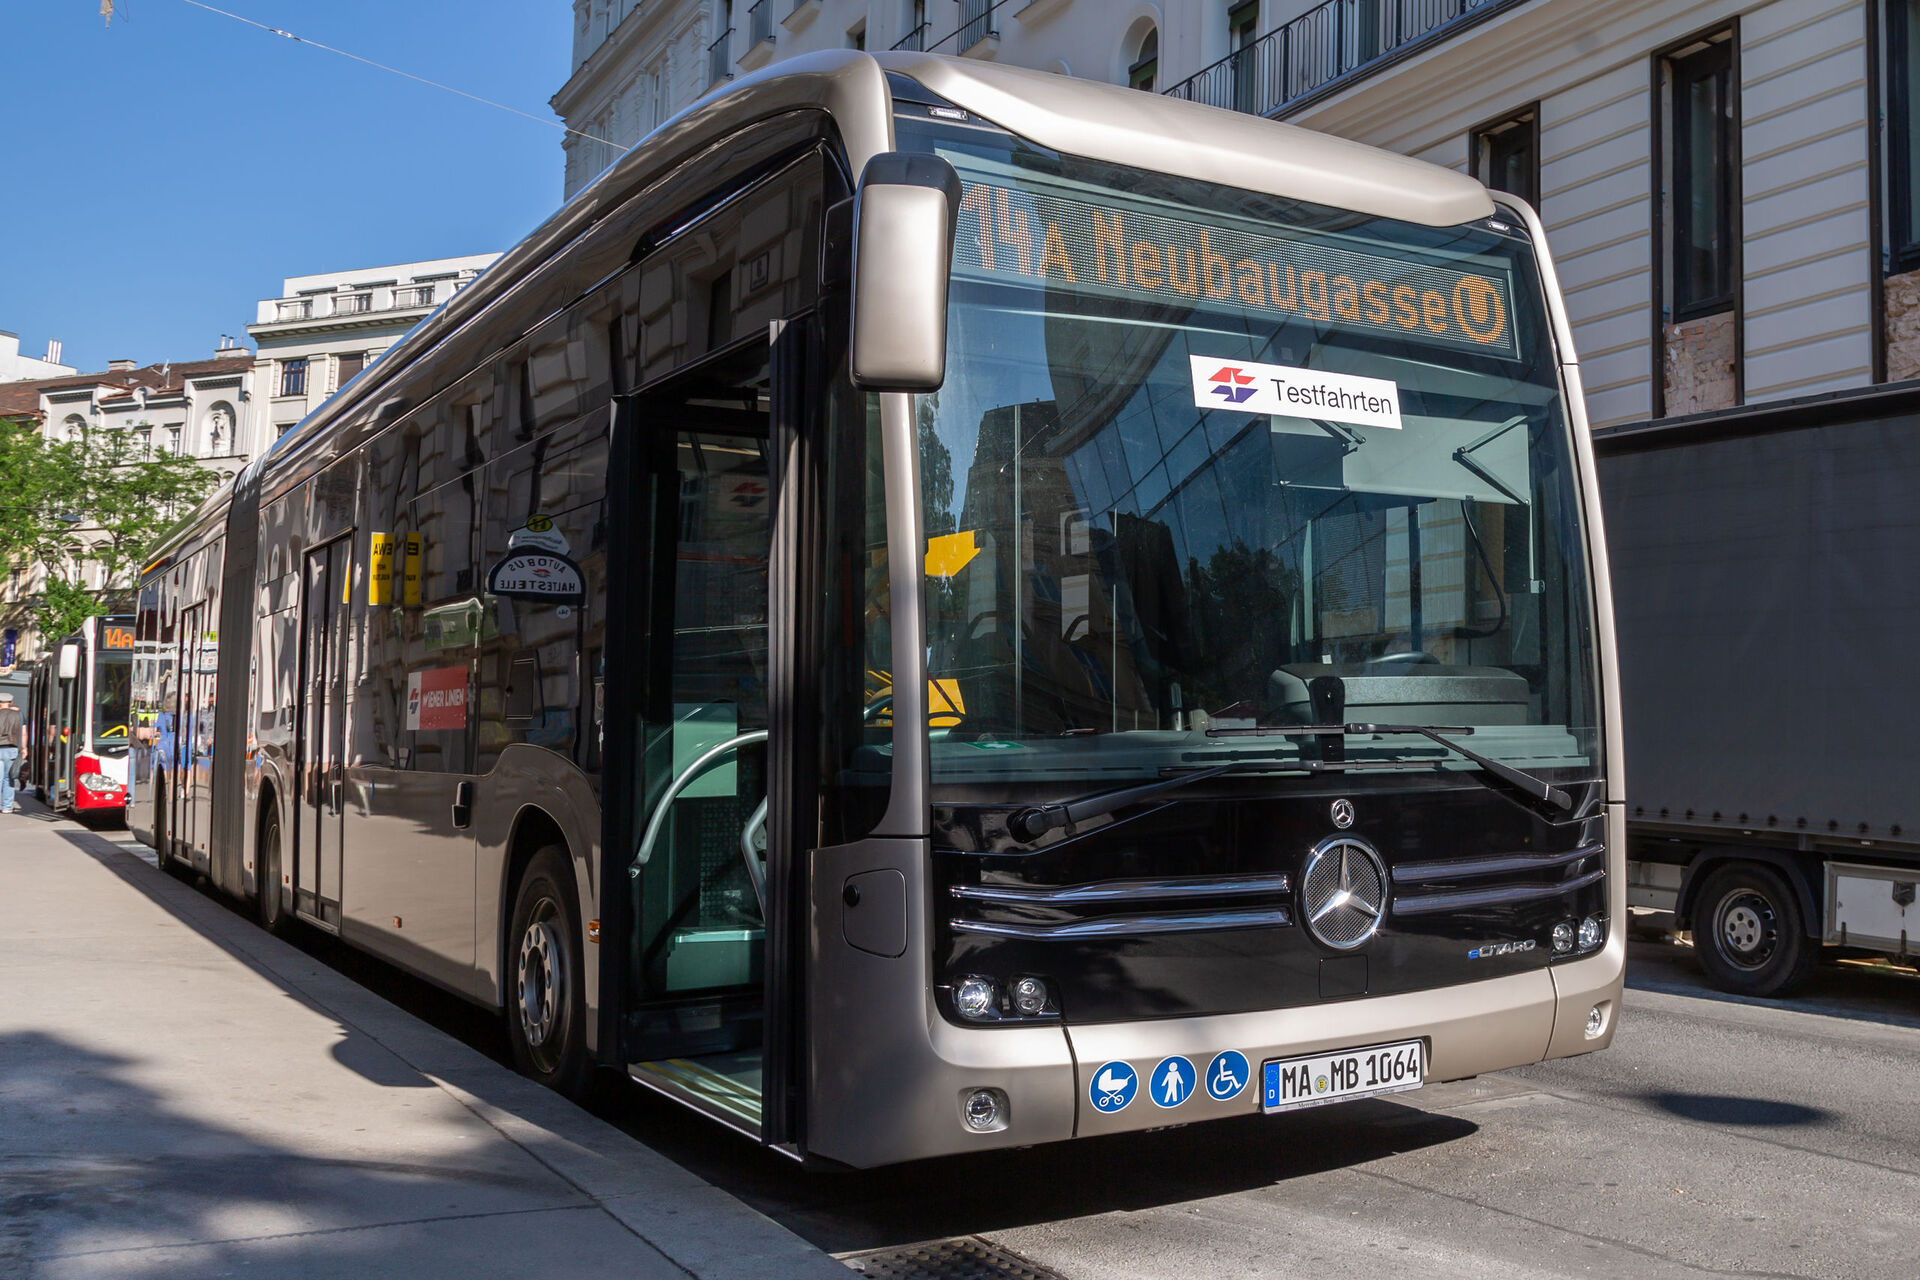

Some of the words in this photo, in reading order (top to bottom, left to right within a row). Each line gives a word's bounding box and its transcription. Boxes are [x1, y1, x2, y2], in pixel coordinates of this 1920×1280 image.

[961, 184, 1076, 283] 14A
[1094, 211, 1448, 333] Neubaugasse
[1457, 281, 1502, 338] U
[1270, 378, 1393, 415] Testfahrten
[105, 628, 134, 648] 14A
[423, 689, 445, 708] WIENER
[1268, 1090, 1275, 1099] D
[1282, 1065, 1312, 1099] MA
[1330, 1058, 1359, 1092] MB
[1366, 1048, 1418, 1086] 1064
